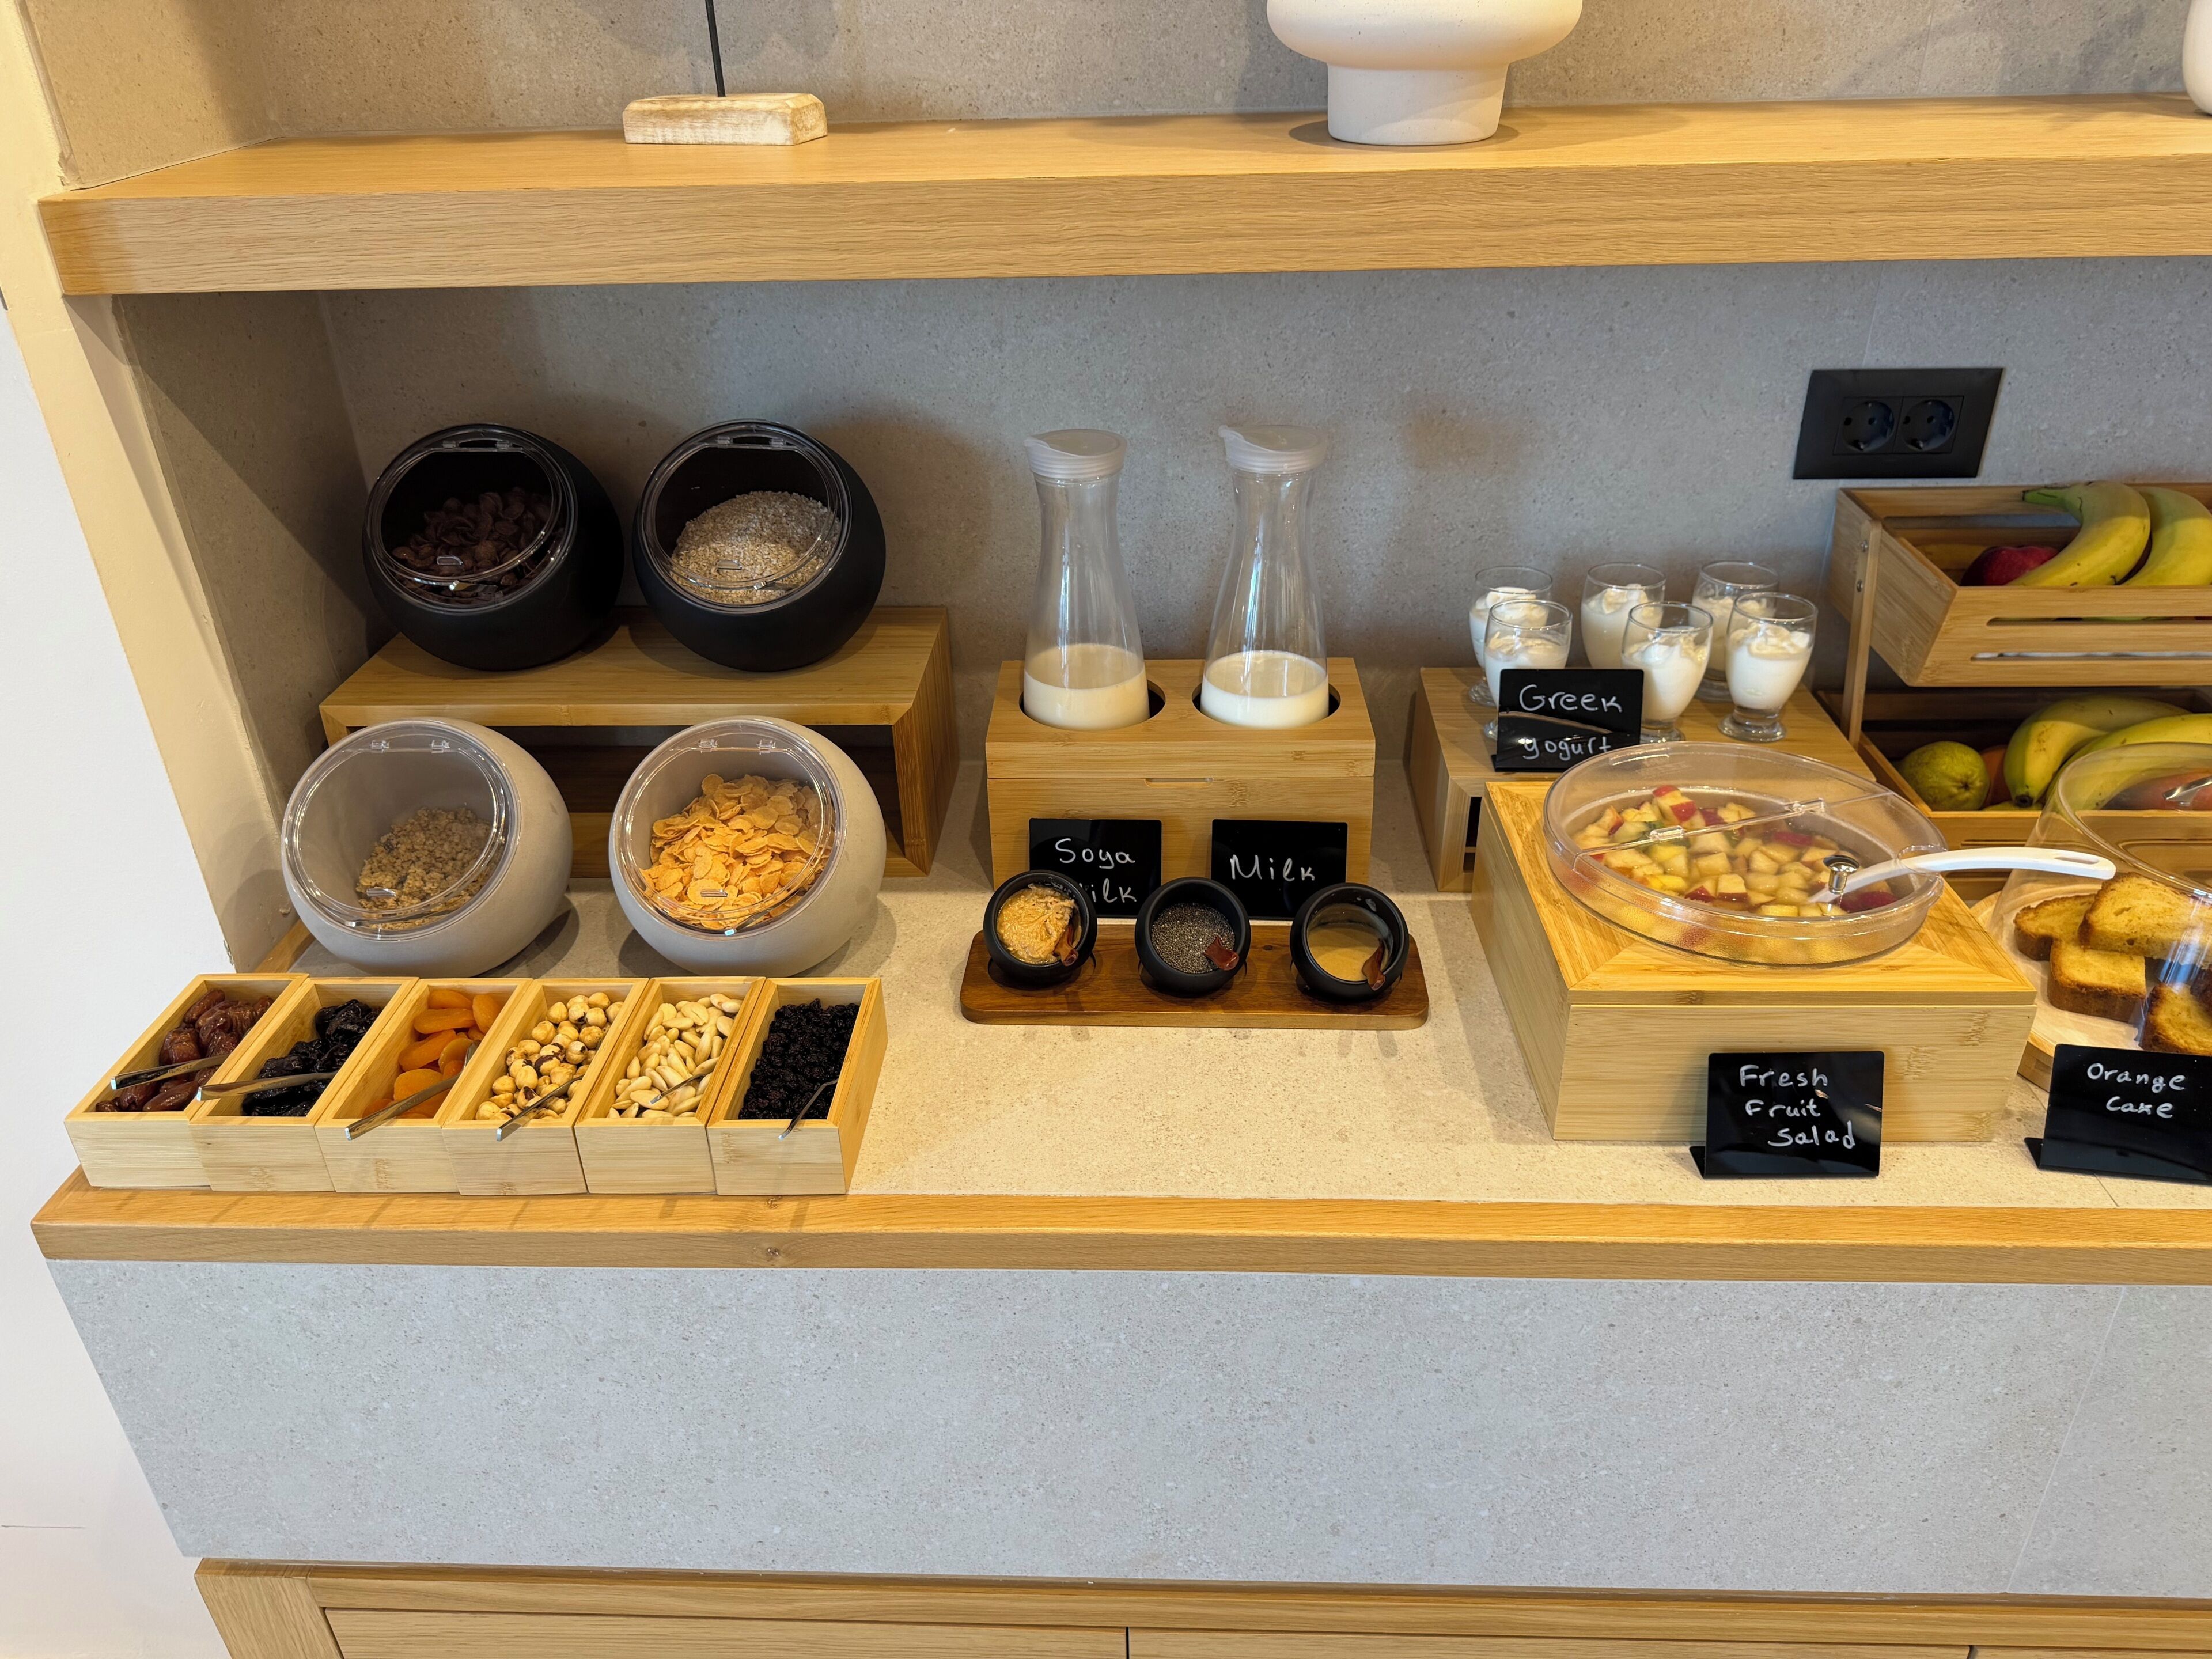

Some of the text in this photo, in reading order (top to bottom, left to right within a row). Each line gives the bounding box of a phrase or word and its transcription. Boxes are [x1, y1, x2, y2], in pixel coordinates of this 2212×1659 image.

[1519, 684, 1622, 713] Greek
[1522, 736, 1613, 761] yogurt
[1055, 838, 1135, 869] Soya
[1229, 854, 1315, 882] Milk
[1078, 878, 1137, 903] ilk
[1739, 1064, 1828, 1087] Fresh
[2086, 1062, 2186, 1093] Orange
[1745, 1098, 1821, 1118] Fruit
[2105, 1096, 2174, 1119] Cake
[1767, 1120, 1856, 1149] Salad
